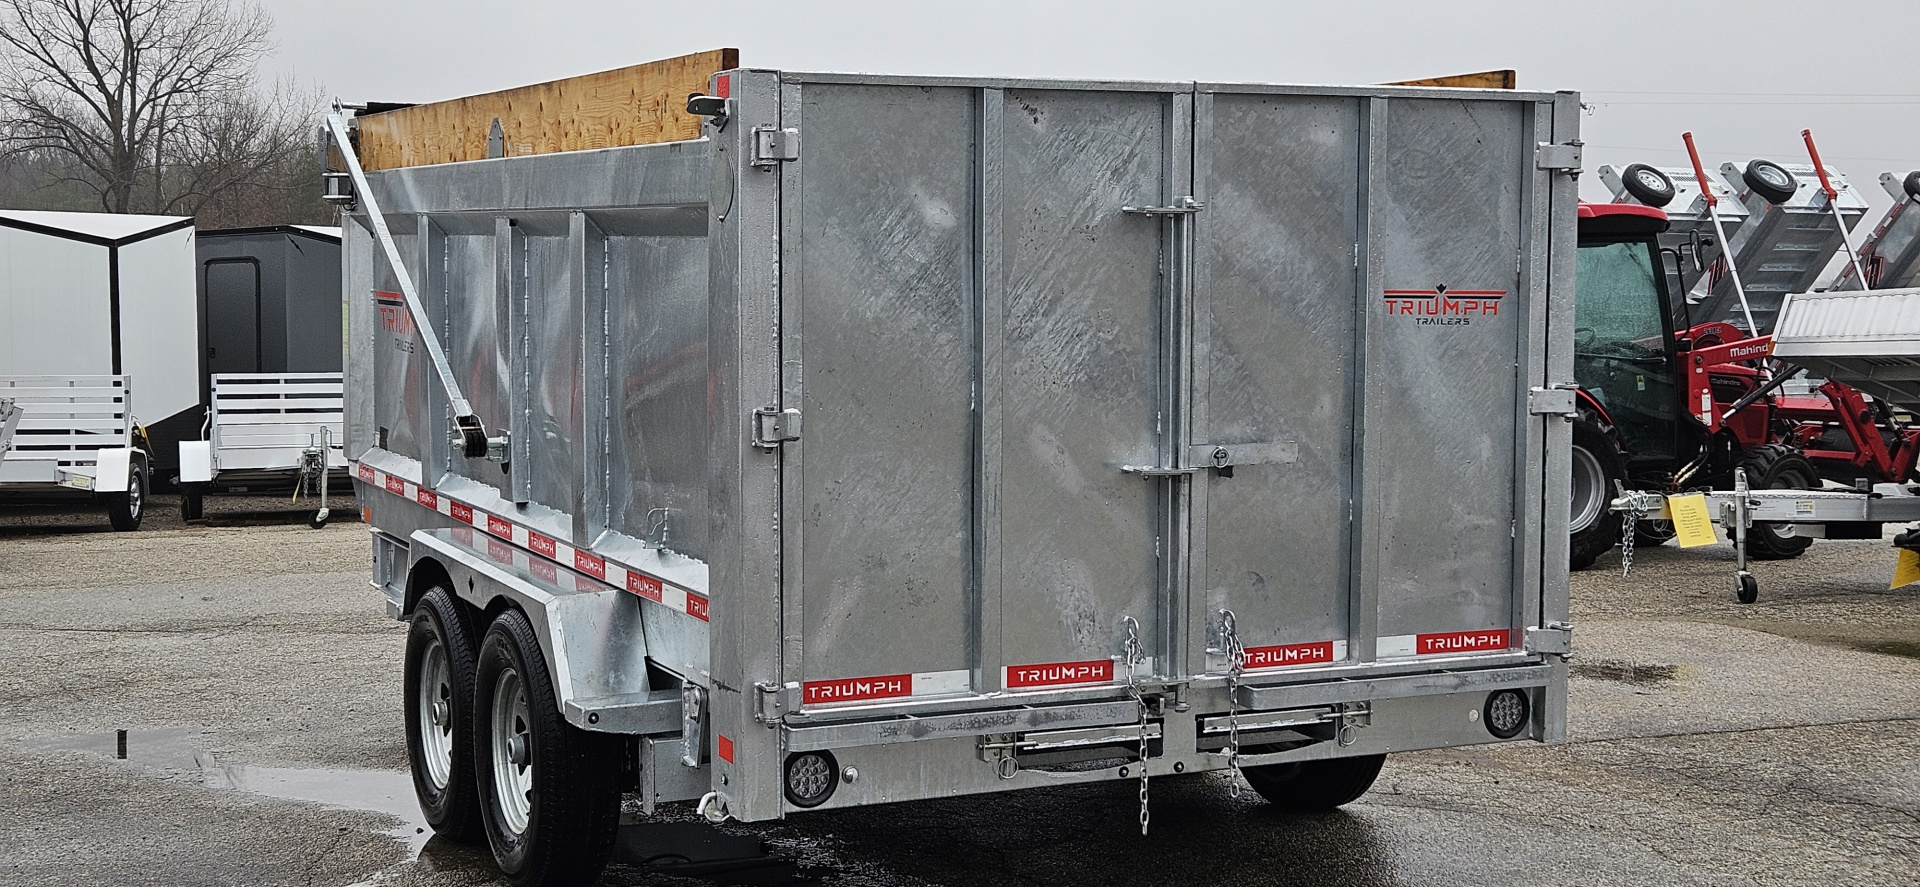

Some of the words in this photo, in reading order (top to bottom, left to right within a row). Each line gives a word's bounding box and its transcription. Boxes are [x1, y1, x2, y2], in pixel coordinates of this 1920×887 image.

[1385, 296, 1499, 315] TRIUMPH
[1415, 317, 1470, 326] TRAILERS
[489, 519, 511, 536] TRIUMPH
[530, 536, 554, 554] TRIUMPH
[577, 555, 603, 575] TRIUMPH
[629, 576, 660, 597] TRIUMPH
[1425, 633, 1501, 651] TRIUMPH
[1244, 647, 1325, 664] TRIUMPH
[1017, 665, 1104, 683] TRIUMPH
[808, 681, 902, 700] TRIUMPH
